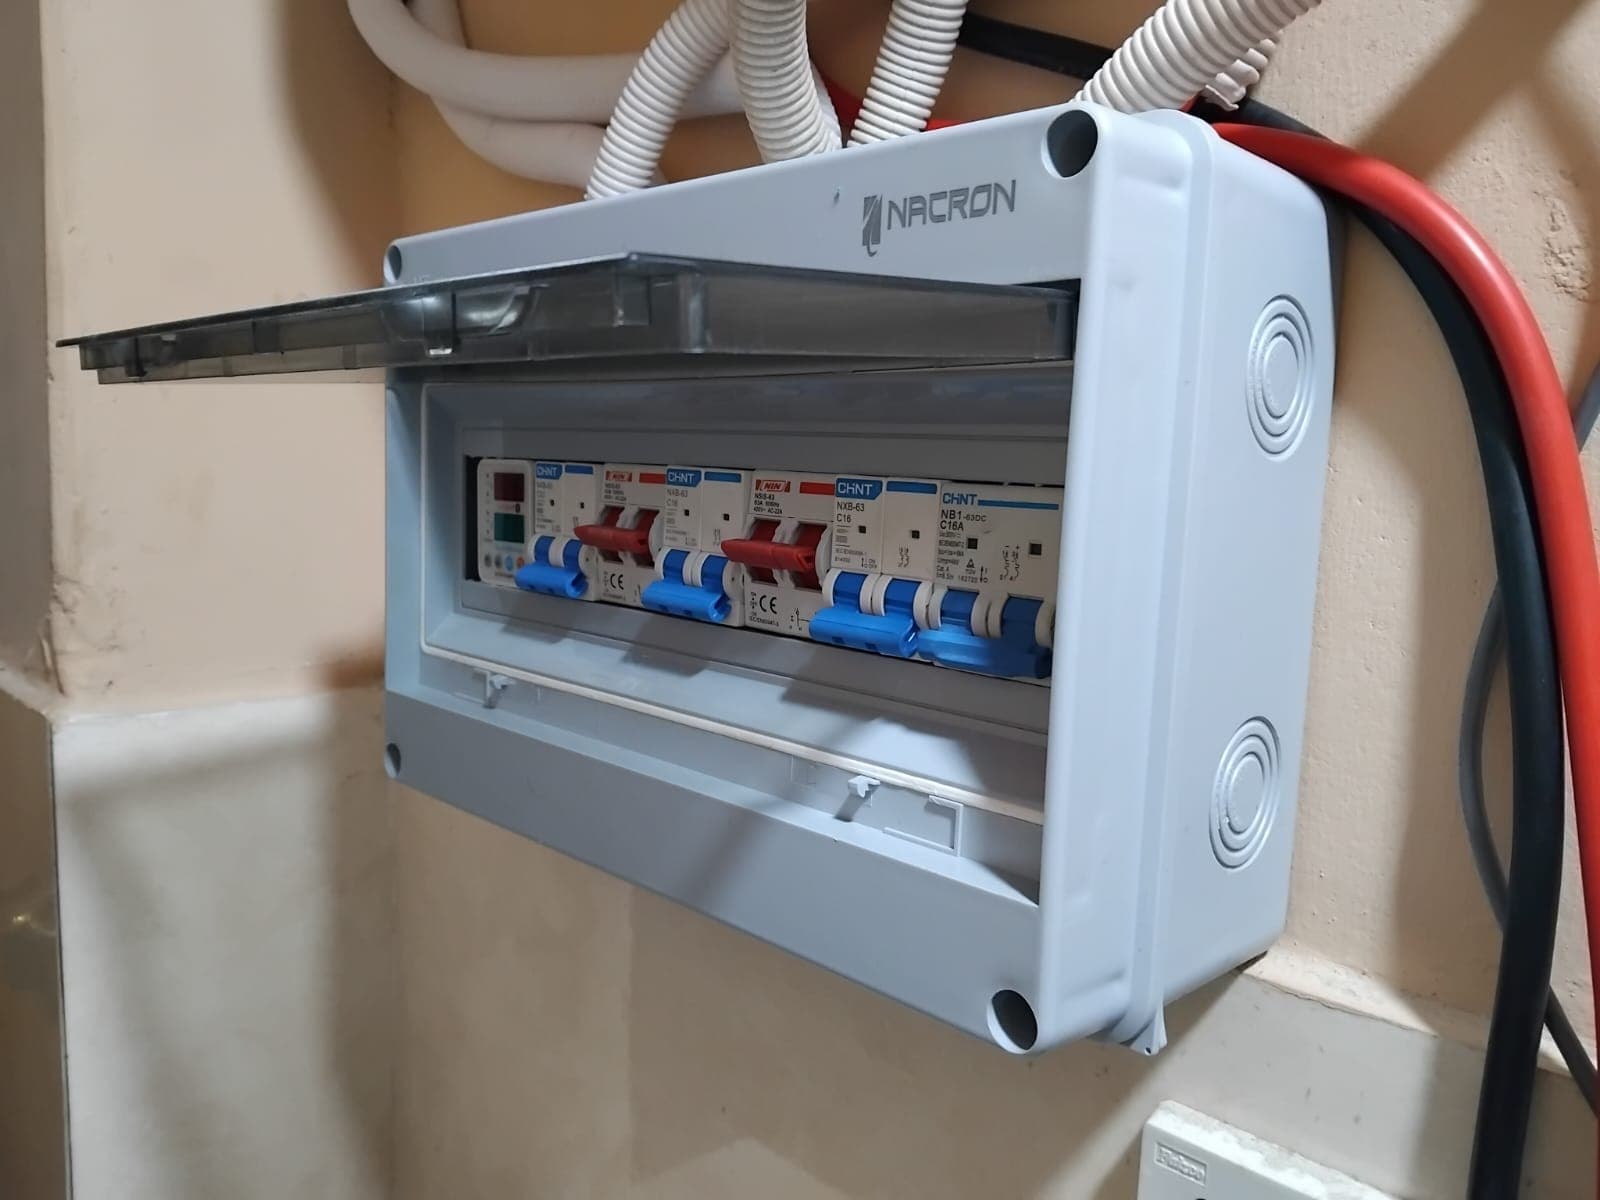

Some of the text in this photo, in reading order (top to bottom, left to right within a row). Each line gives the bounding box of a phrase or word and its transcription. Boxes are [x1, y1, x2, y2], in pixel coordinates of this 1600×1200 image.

[887, 179, 1017, 231] NACRON
[836, 502, 865, 512] NXB-63
[836, 513, 852, 523] C16
[939, 520, 964, 531] C16A
